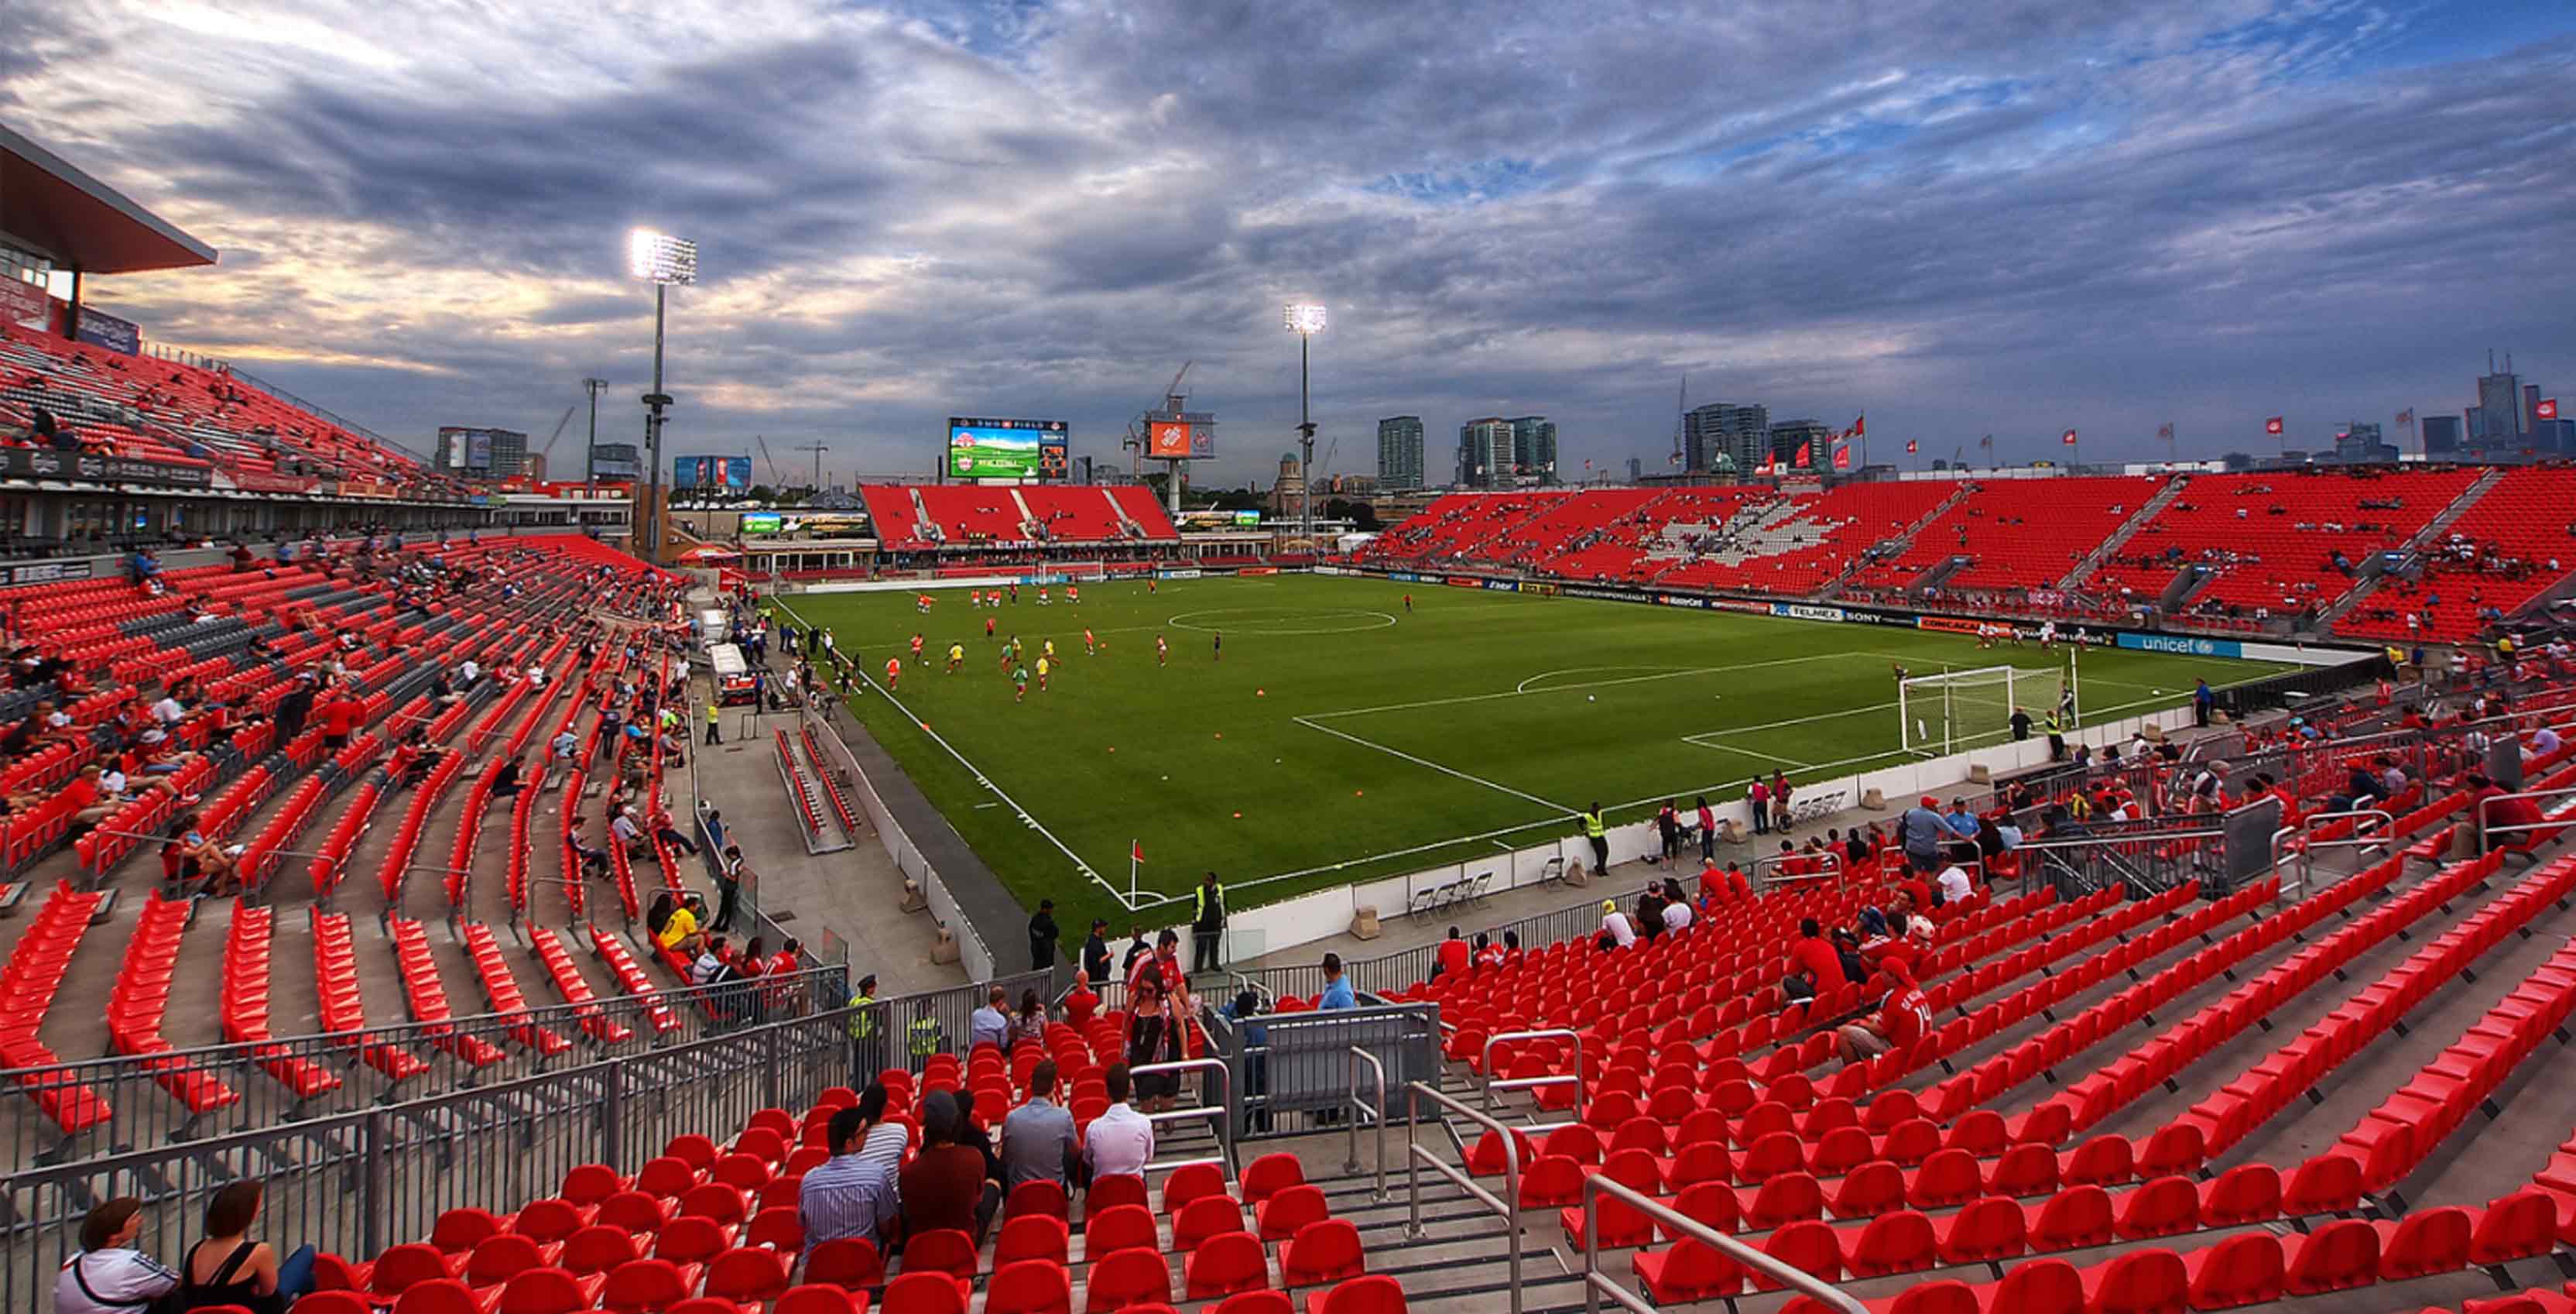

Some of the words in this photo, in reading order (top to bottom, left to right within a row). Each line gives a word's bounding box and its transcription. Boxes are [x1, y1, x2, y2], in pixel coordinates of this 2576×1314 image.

[1670, 596, 1703, 607] MasterCard
[1793, 608, 1838, 619] TELMEX
[1846, 612, 1882, 623] SONY
[1923, 619, 1986, 633] CONCACA
[2143, 636, 2193, 654] unicef
